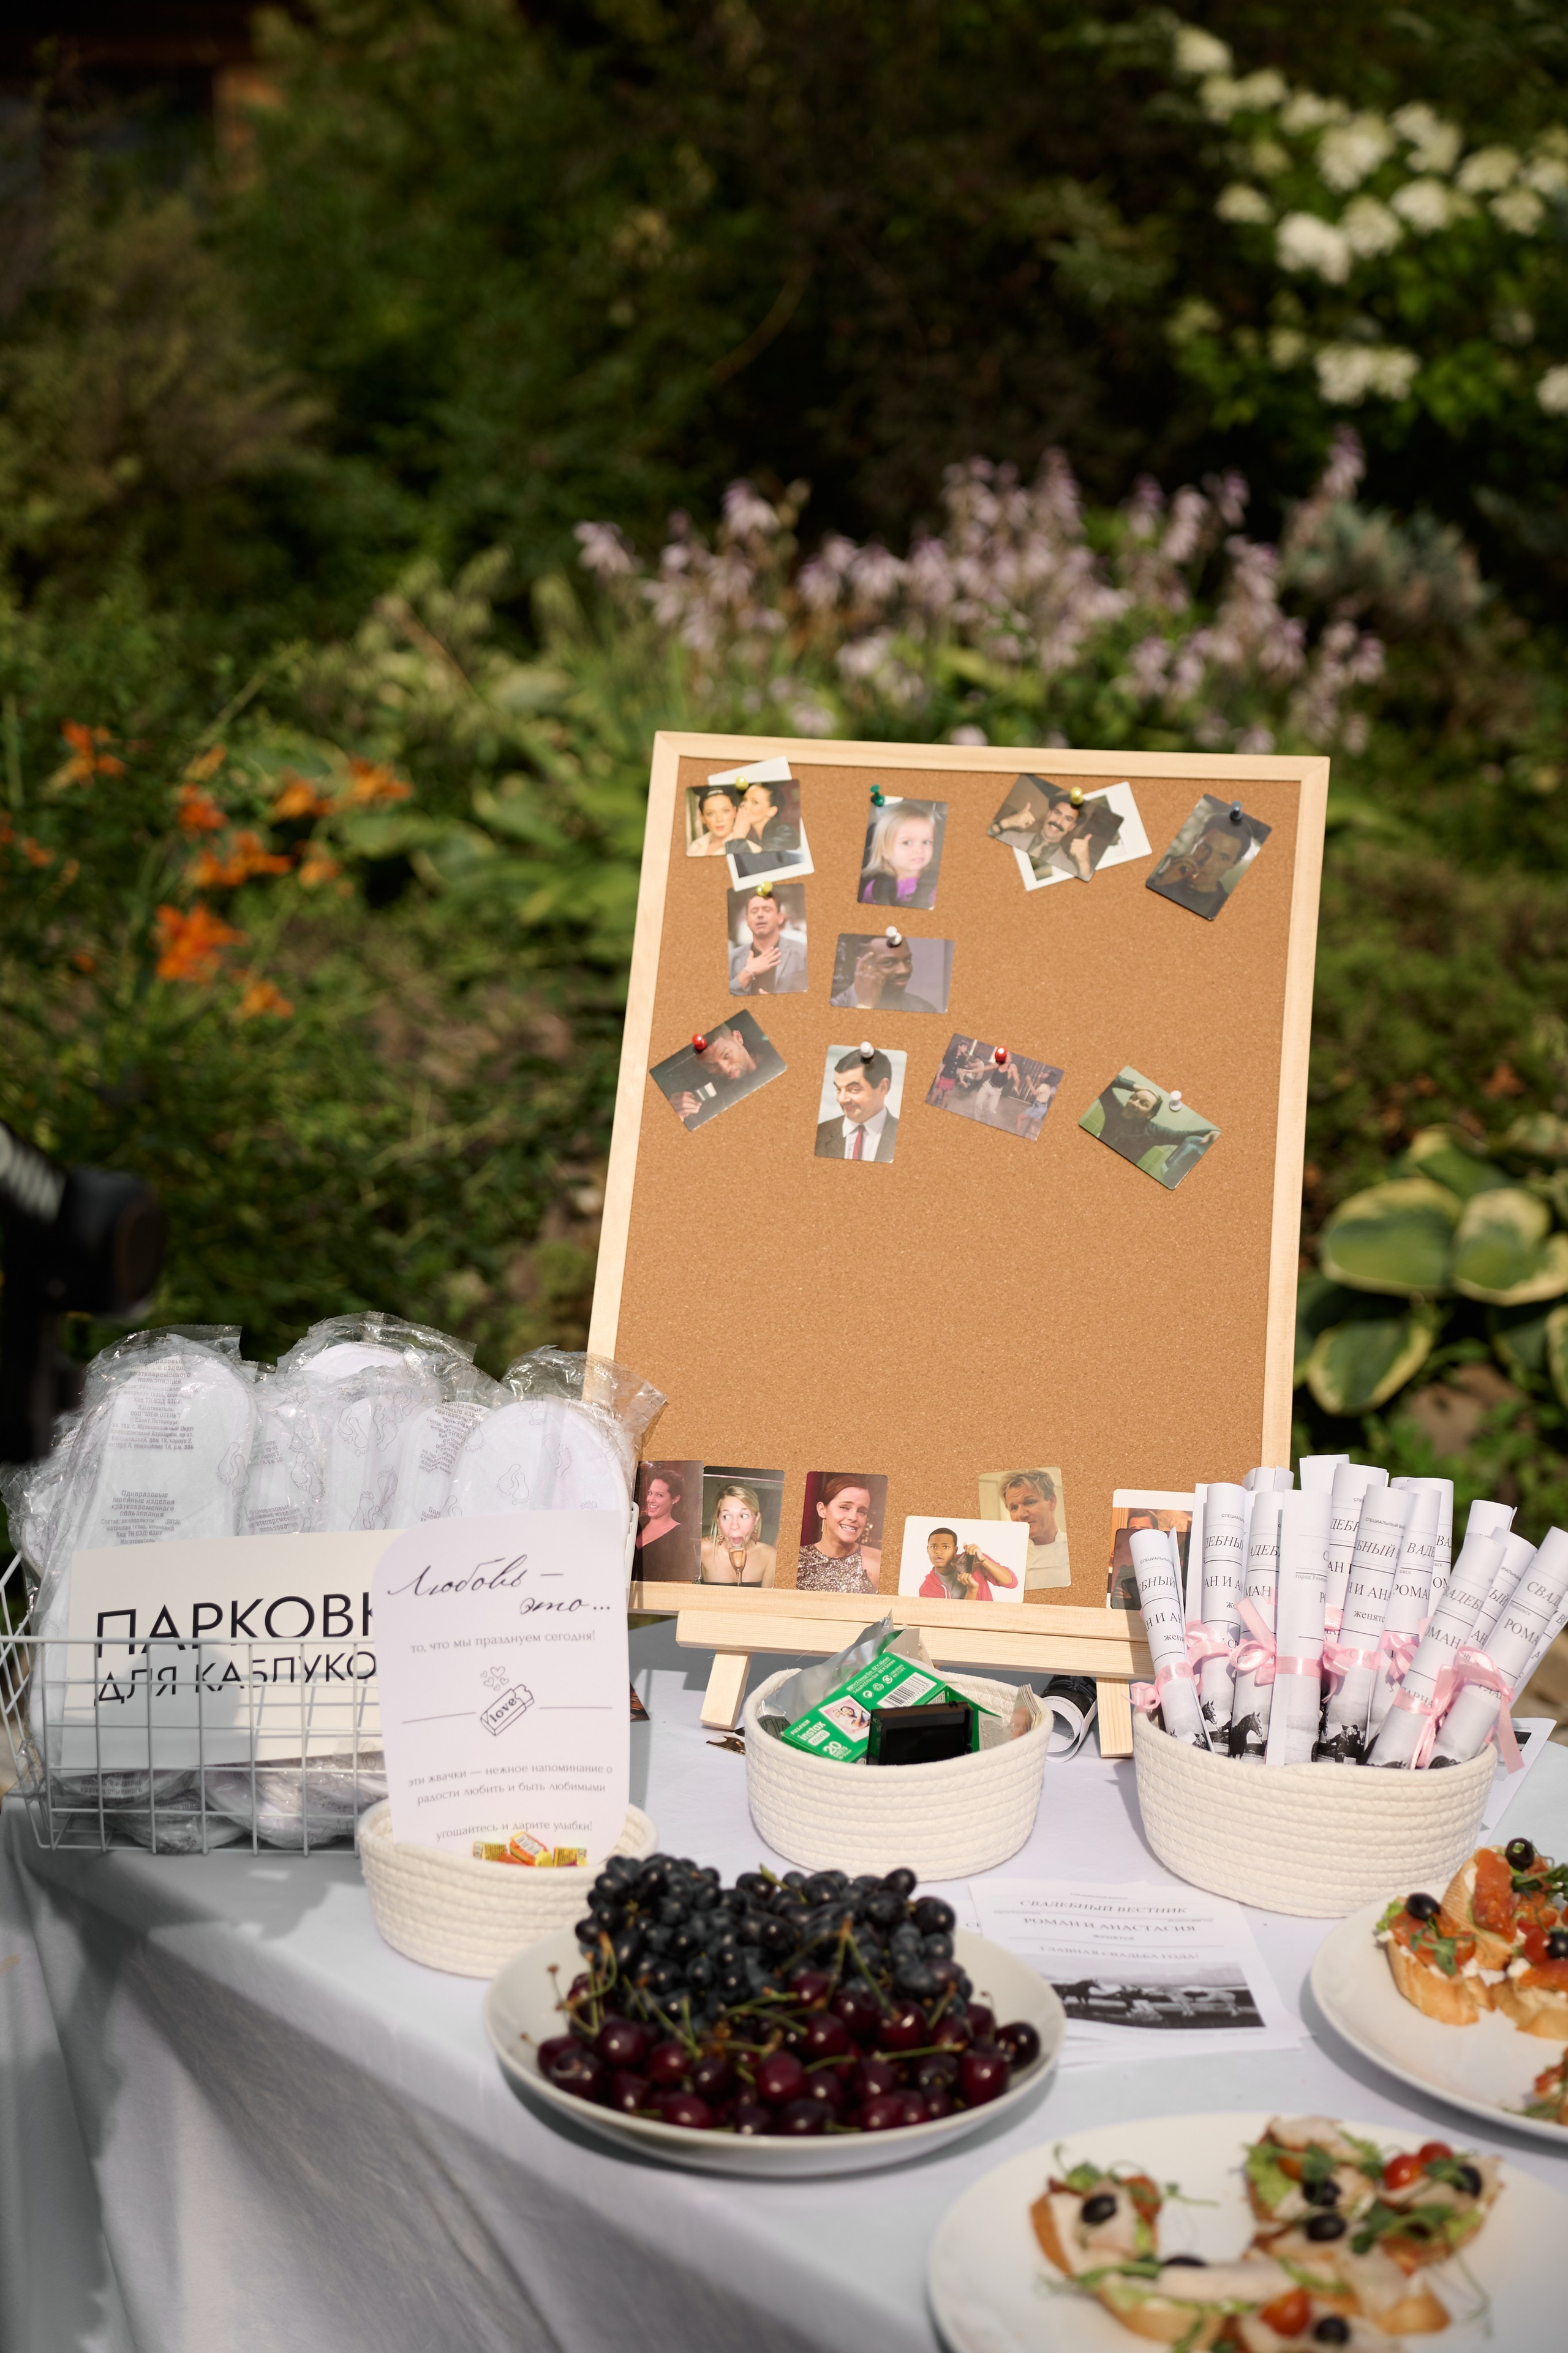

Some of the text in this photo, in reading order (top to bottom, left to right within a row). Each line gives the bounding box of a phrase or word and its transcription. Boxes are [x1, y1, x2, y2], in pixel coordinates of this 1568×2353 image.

[121, 1489, 168, 1498] Одноразовые
[387, 1554, 528, 1596] Любовь
[1504, 1617, 1540, 1646] РОМА
[410, 1630, 596, 1654] то, что мы празднуем сегодня!
[94, 1651, 377, 1707] ДЛЯ КАБЛУКО
[489, 1698, 517, 1723] love
[790, 1719, 810, 1735] FUJIFILM
[797, 1721, 826, 1741] instax
[812, 1731, 828, 1745] mini
[823, 1740, 842, 1756] 20
[408, 1763, 613, 1788] эти жвачки нежное напоминание о
[417, 1781, 606, 1807] радости любить и быть любимыми
[436, 1824, 499, 1842] угощайтесь
[512, 1821, 551, 1832] дарите
[553, 1821, 593, 1833] улыбки!
[1020, 1900, 1112, 1912] СВАДЕБНЫЙ
[1024, 1917, 1080, 1928] РОМАН
[1099, 1924, 1197, 1932] АНАСТАСИЯ
[1039, 1945, 1099, 1956] ГЛАВНАЯ
[1101, 1951, 1159, 1959] СВАДЬБА
